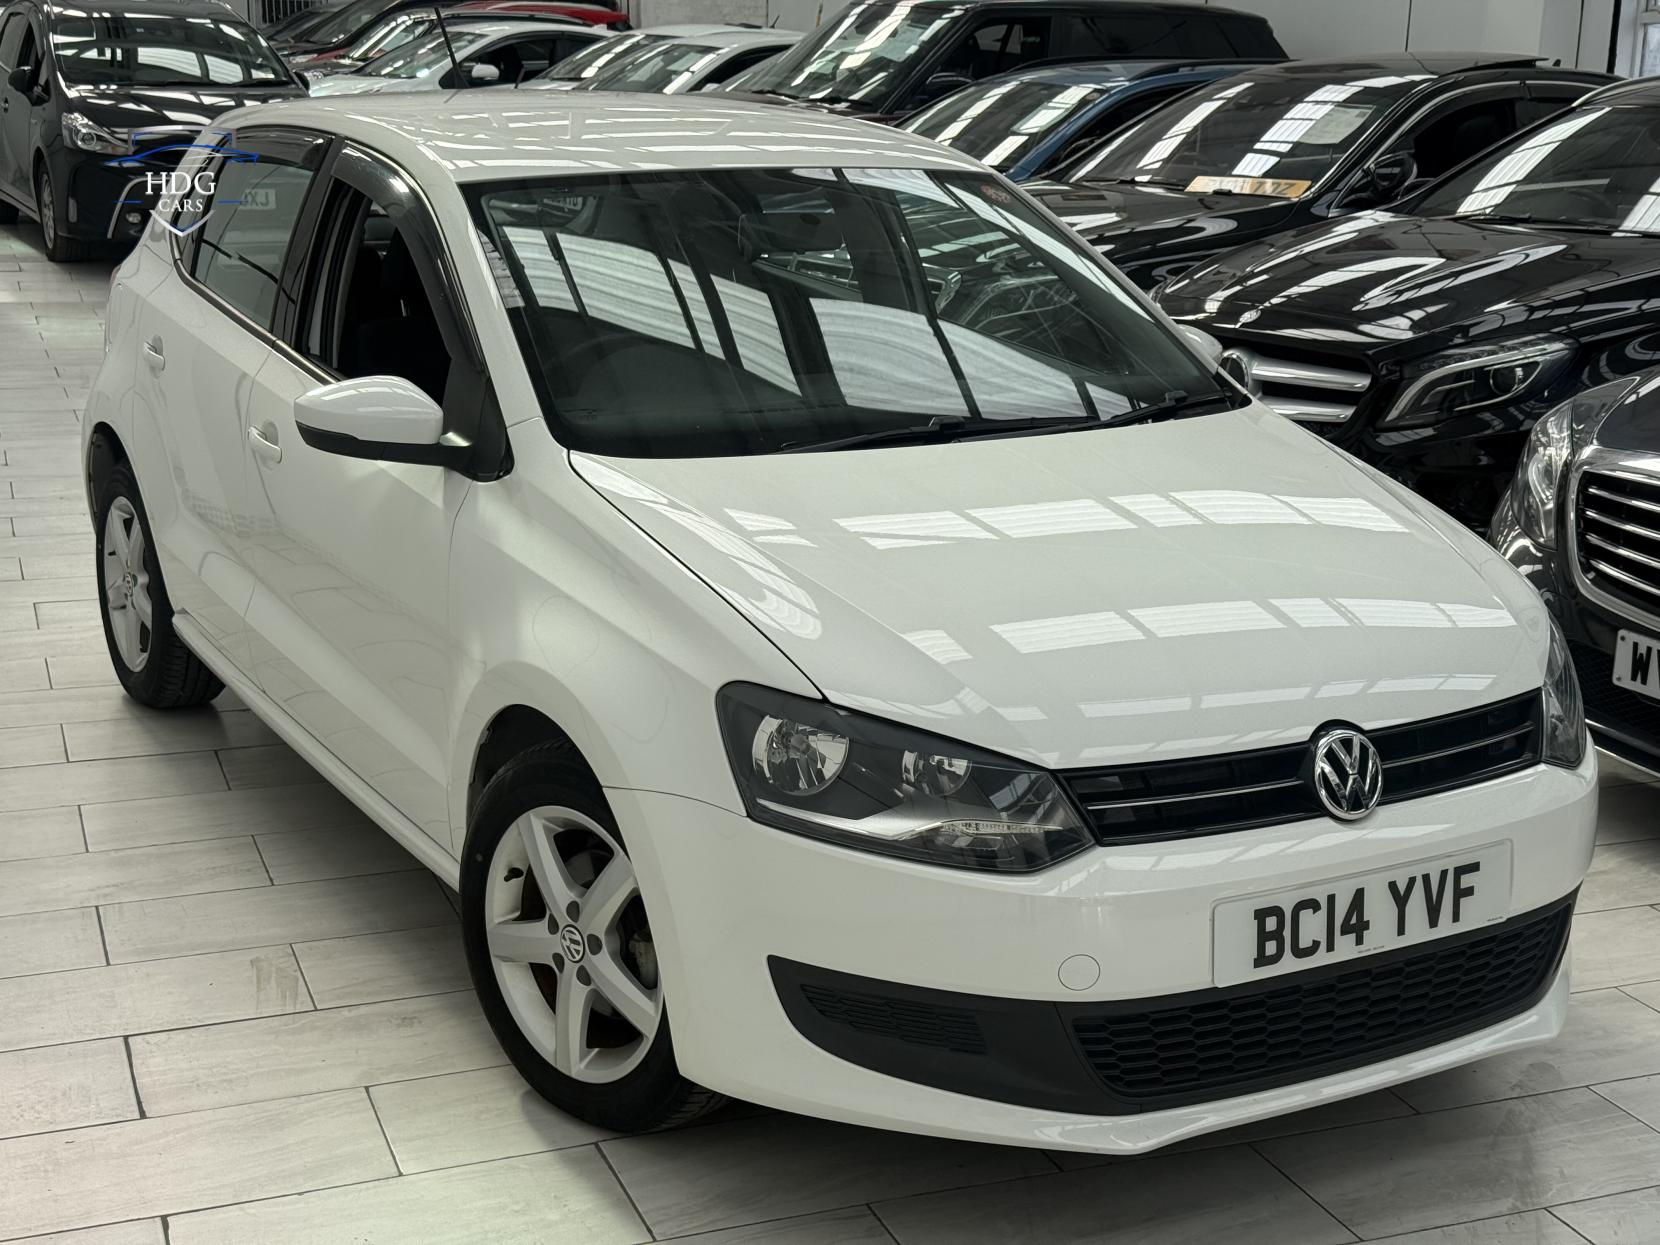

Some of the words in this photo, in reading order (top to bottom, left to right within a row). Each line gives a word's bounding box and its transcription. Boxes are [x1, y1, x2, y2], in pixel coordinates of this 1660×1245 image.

[1630, 641, 1660, 691] W
[1253, 887, 1370, 969] BC14
[1388, 861, 1480, 936] YVF
